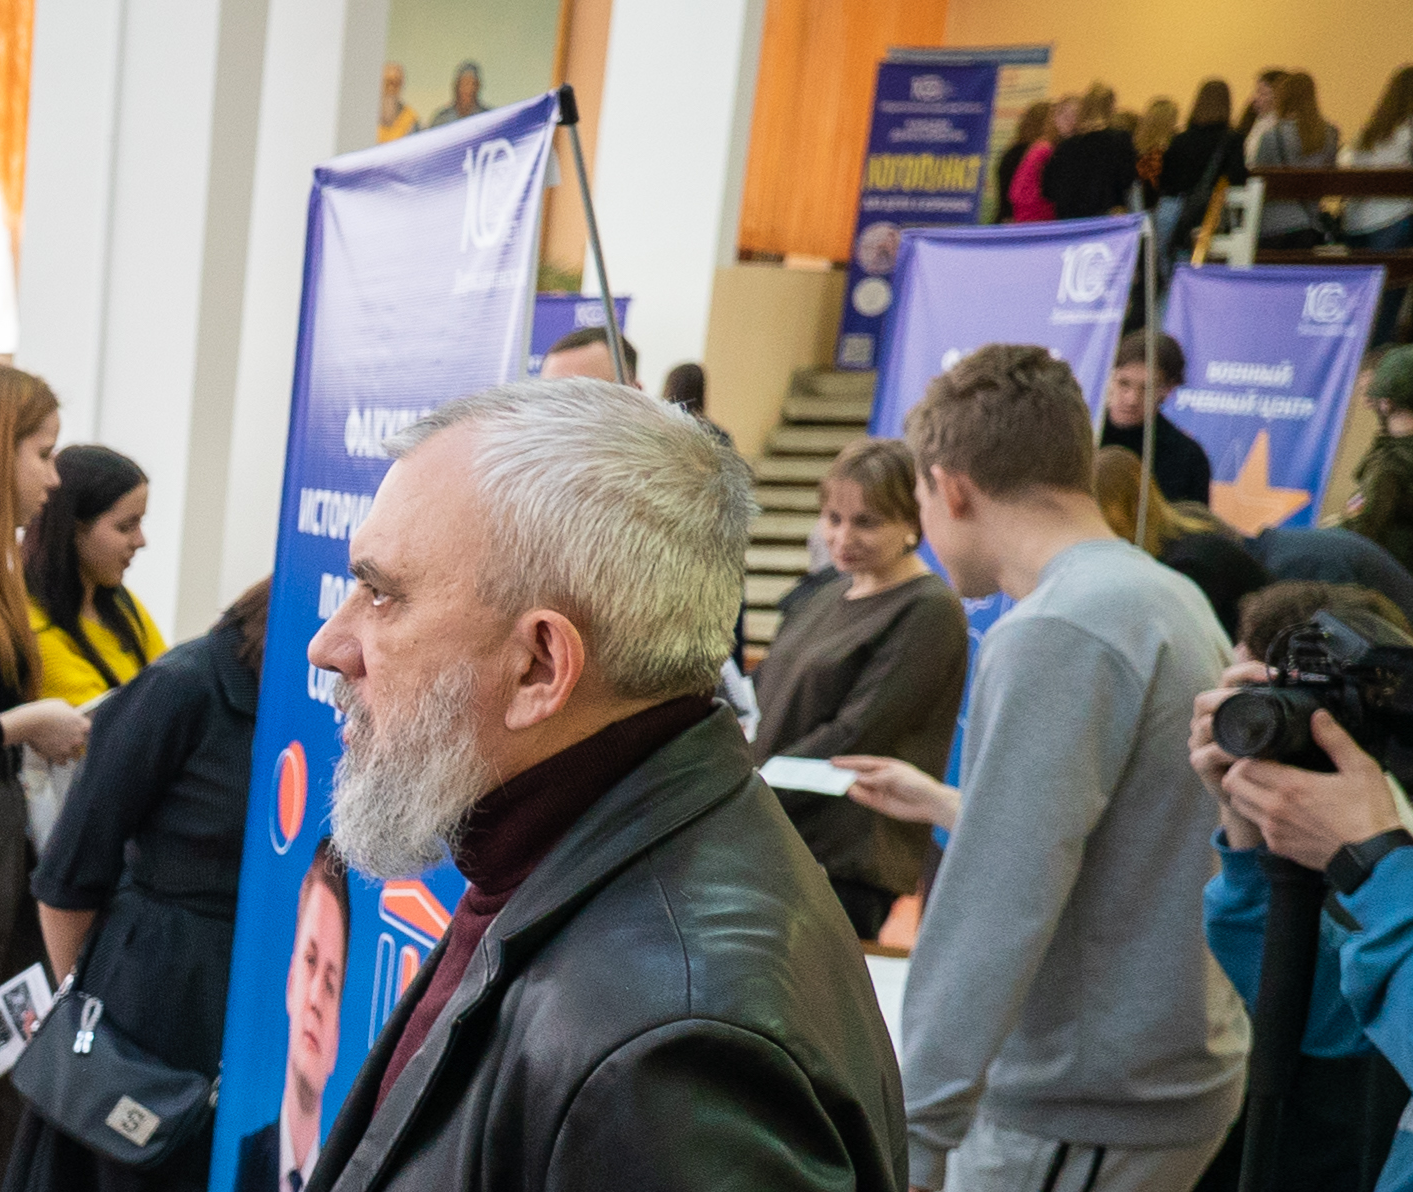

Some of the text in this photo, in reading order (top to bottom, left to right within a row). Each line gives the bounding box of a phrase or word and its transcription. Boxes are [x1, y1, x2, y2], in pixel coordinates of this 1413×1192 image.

[1206, 360, 1294, 388] ВОЕННЫЙ
[1176, 388, 1314, 421] УЧЕБНЫЙ ЦЕНТР
